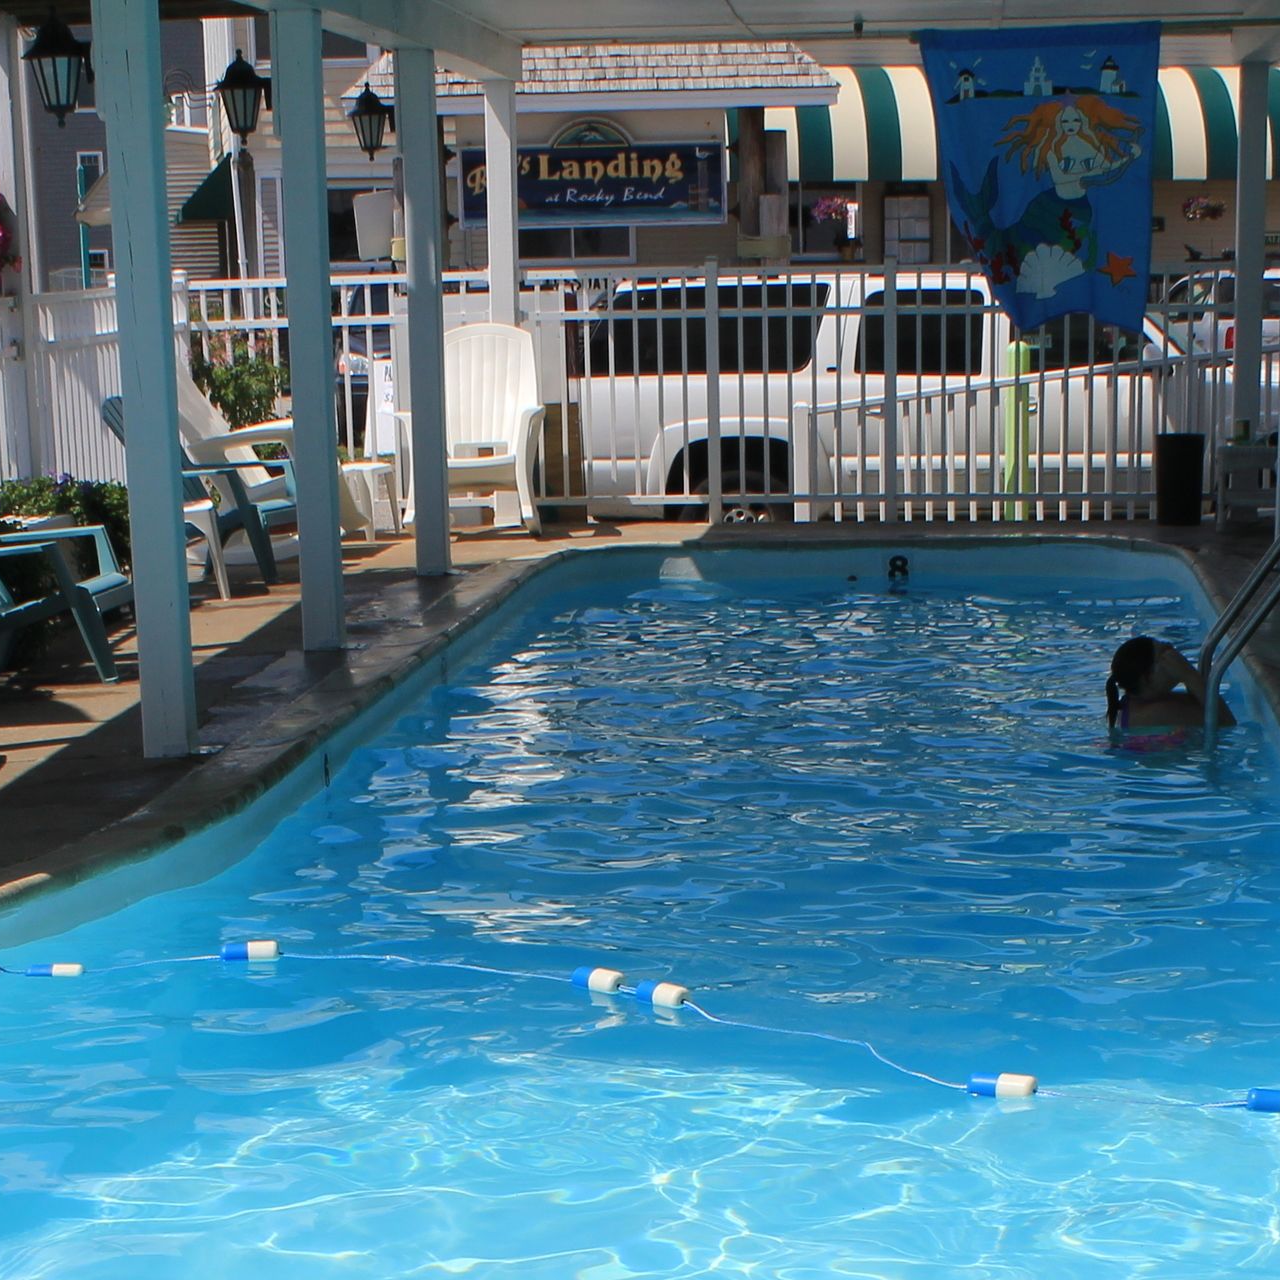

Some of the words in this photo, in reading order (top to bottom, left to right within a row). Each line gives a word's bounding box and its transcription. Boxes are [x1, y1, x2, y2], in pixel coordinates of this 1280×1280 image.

[537, 152, 685, 183] Landing
[545, 192, 561, 203] at
[566, 188, 615, 206] Rocky
[622, 187, 665, 202] Bend
[888, 554, 910, 579] 8
